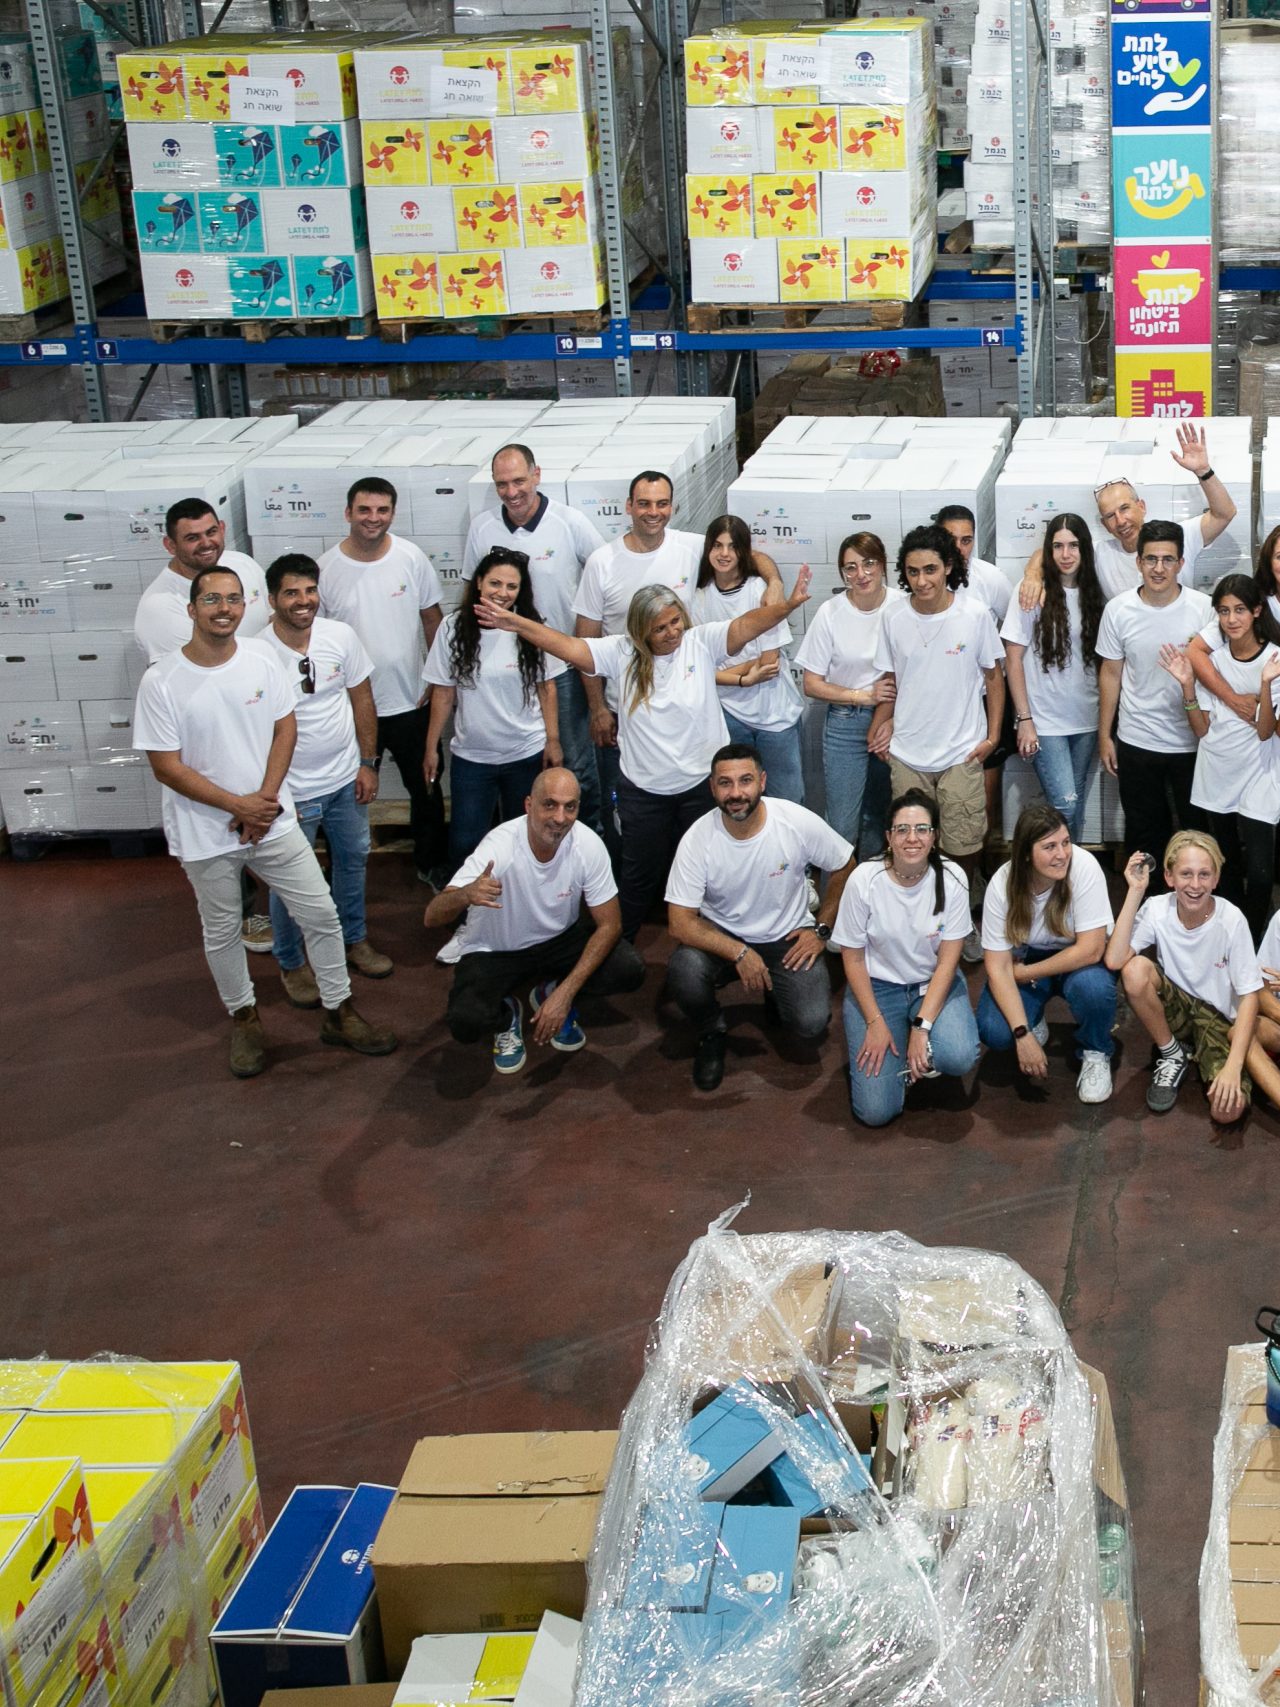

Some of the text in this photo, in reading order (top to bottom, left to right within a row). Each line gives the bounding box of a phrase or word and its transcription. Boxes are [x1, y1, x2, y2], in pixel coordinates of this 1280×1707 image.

[1122, 33, 1168, 52] לתת
[782, 54, 815, 66] הקצאת
[1132, 50, 1179, 73] סיוע
[777, 68, 817, 79] שואה חג
[447, 77, 481, 89] הקצאת
[1117, 69, 1165, 90] לחיים
[246, 88, 279, 99] הקצאת
[444, 91, 484, 102] שואה חג
[243, 101, 283, 112] שואה חג
[1133, 159, 1189, 188] נוער
[1134, 182, 1174, 200] לתת
[1145, 284, 1193, 305] לתת
[1130, 306, 1180, 323] ביטחון
[1130, 321, 1180, 337] תזונתי
[660, 336, 672, 347] 13
[986, 331, 1000, 342] 14
[560, 338, 573, 349] 10
[28, 345, 36, 355] 6
[103, 344, 111, 355] 9
[1152, 400, 1194, 418] לתת
[288, 501, 312, 511] יחד
[773, 526, 797, 537] יחד
